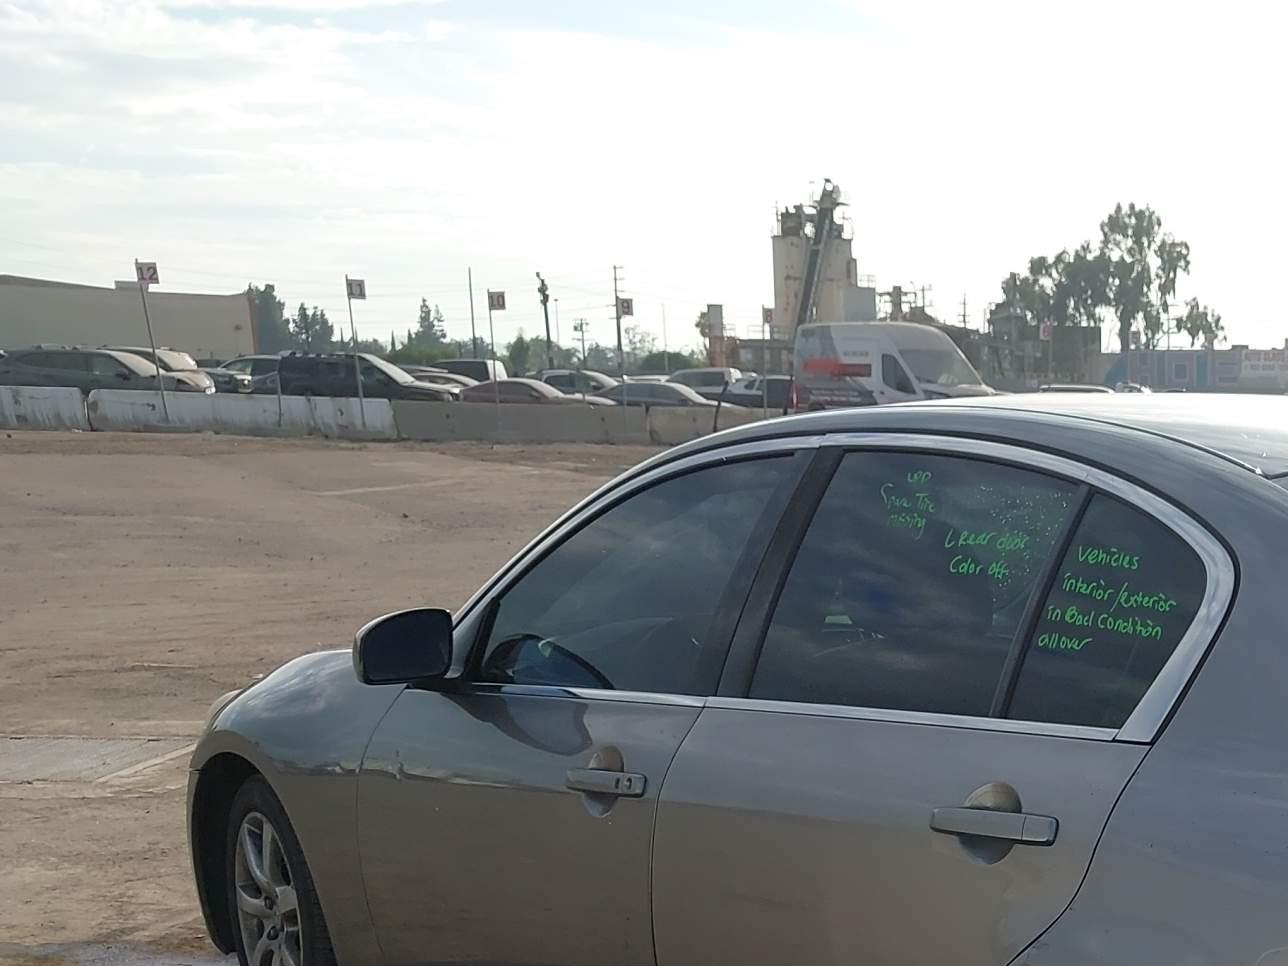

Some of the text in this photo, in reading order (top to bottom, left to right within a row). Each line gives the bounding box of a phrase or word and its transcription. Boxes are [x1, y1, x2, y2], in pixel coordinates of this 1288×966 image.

[138, 266, 158, 281] 12
[347, 282, 365, 297] 11
[489, 294, 505, 308] 10
[1047, 605, 1061, 621] in
